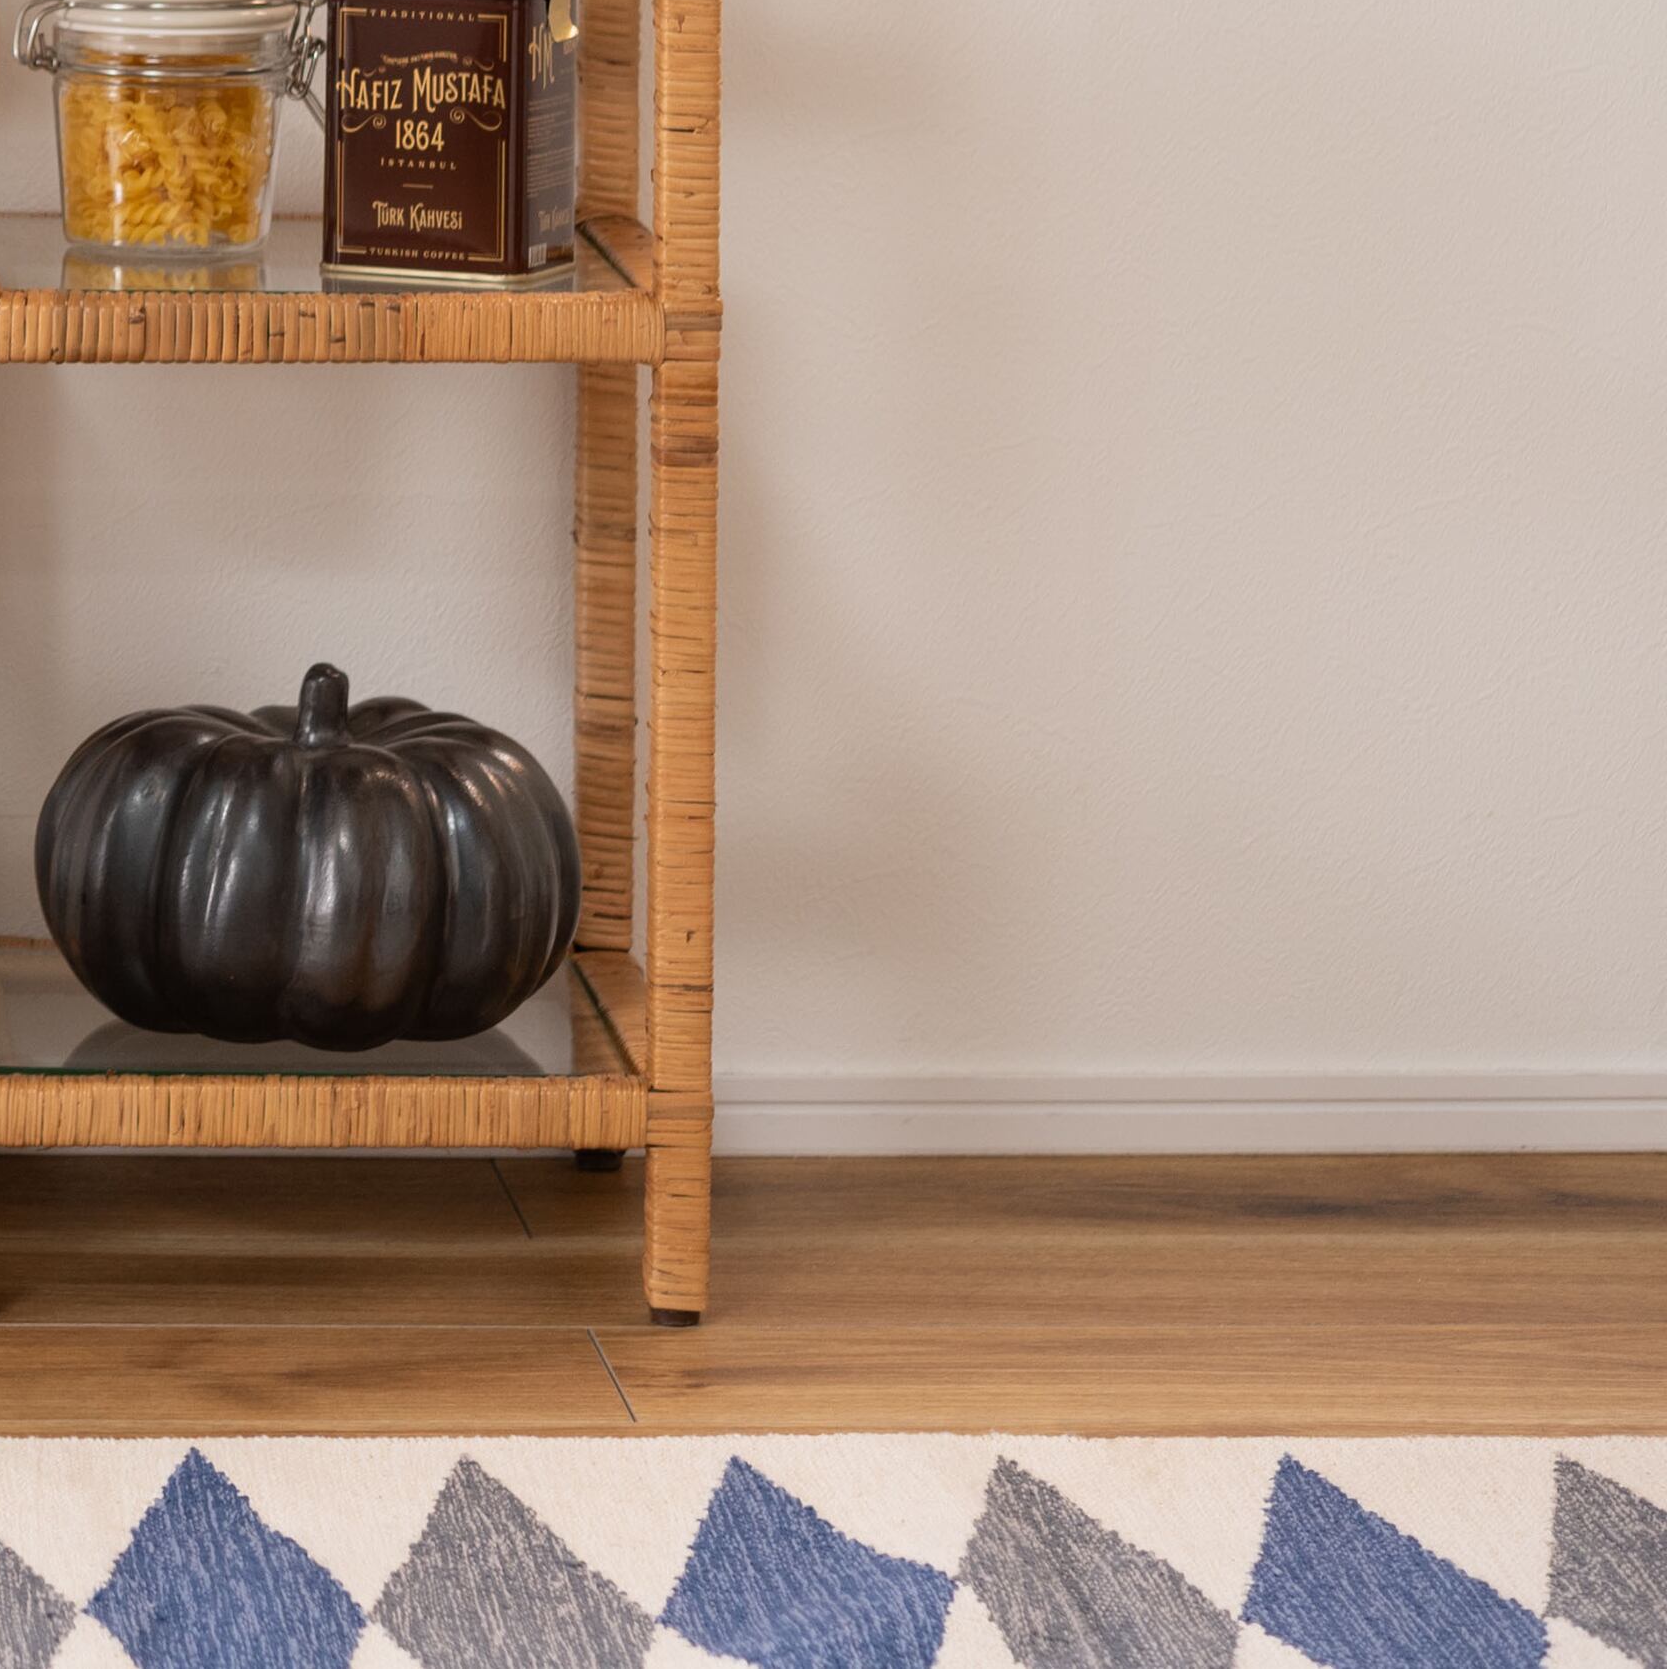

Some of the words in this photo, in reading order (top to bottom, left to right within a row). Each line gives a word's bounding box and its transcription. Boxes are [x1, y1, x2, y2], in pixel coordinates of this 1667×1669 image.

[370, 8, 475, 22] TRADITIONAL
[336, 67, 403, 110] HAFIZ
[412, 66, 506, 113] MUSTAFA
[395, 118, 445, 152] 1864
